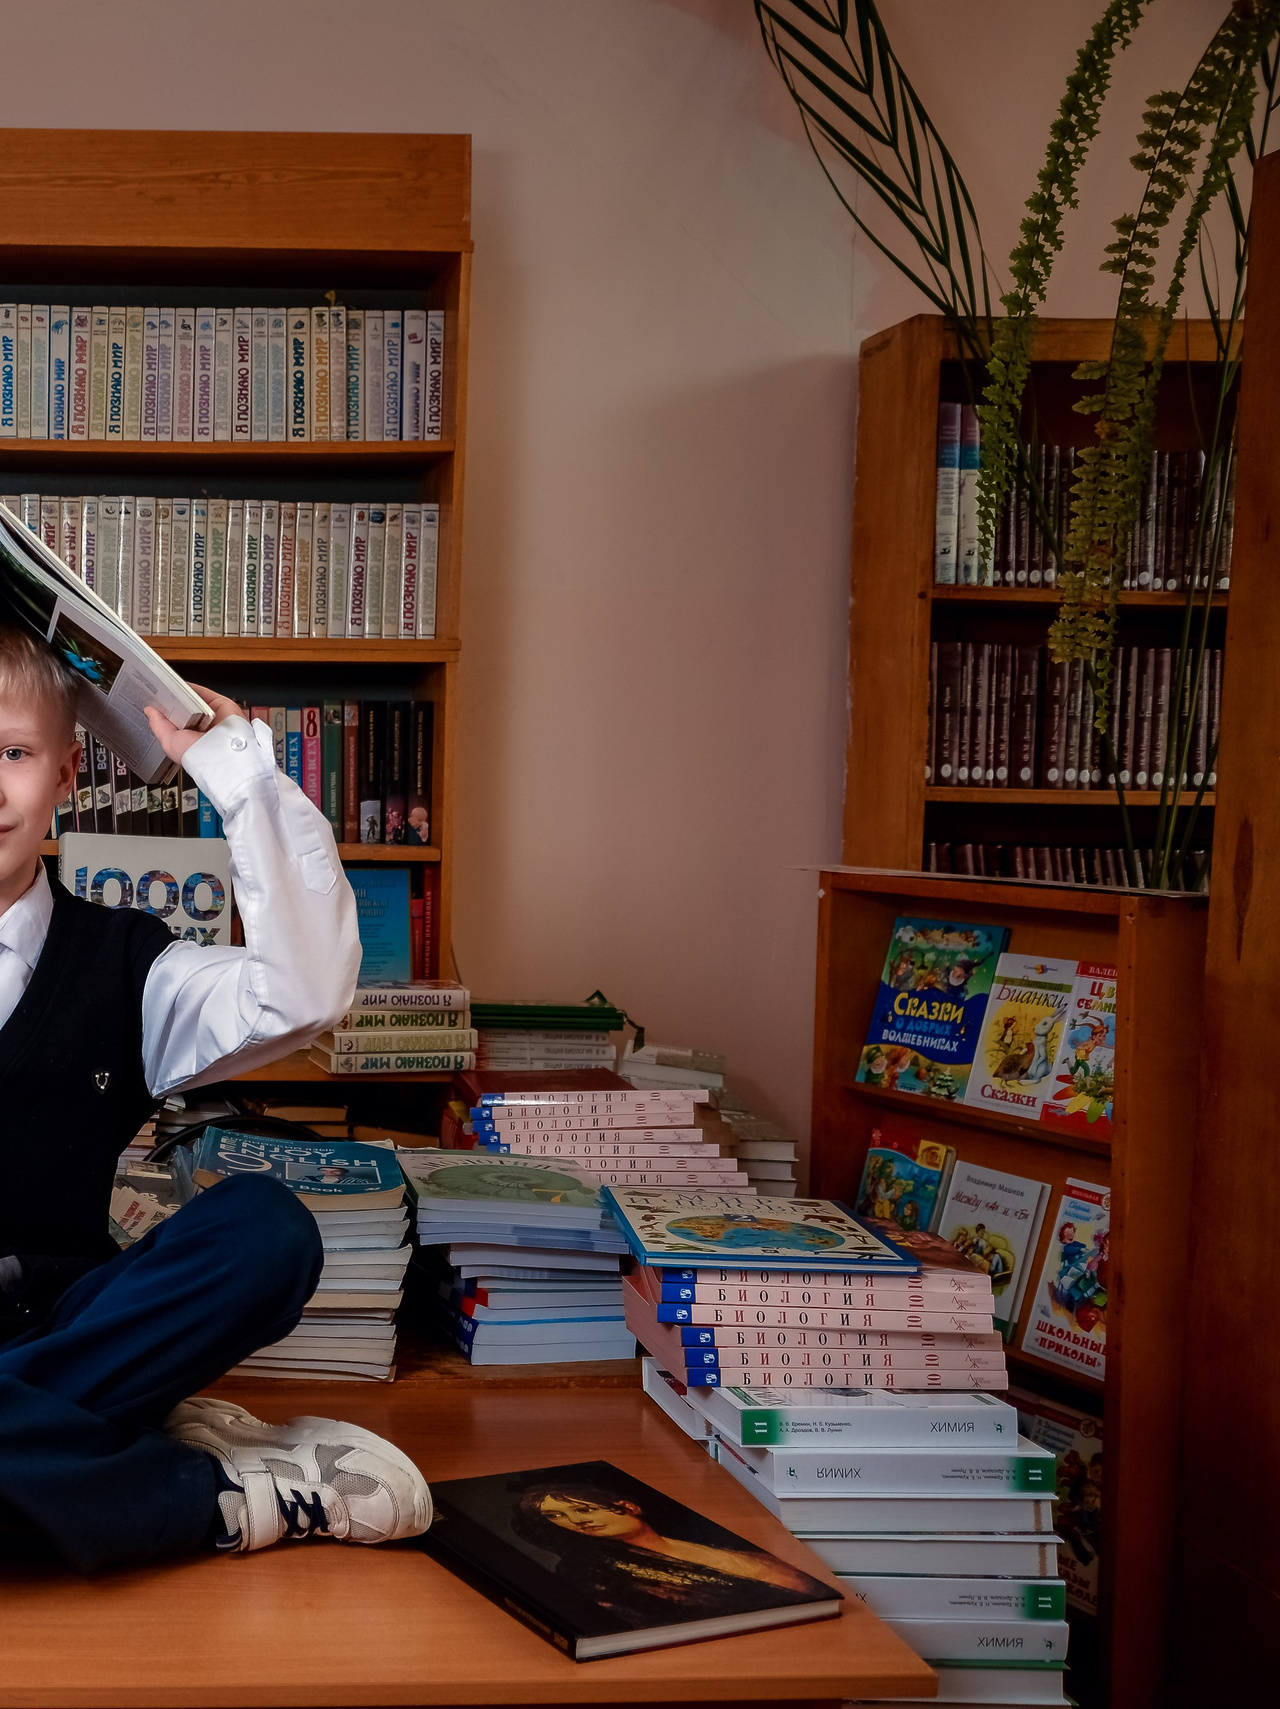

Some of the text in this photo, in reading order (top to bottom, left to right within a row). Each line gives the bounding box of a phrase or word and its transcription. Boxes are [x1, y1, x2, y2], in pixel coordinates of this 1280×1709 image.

[1, 335, 14, 427] Я ПОЗНАЮ МИР
[108, 342, 123, 434] Я ПОЗНАЮ МИР
[292, 337, 305, 438] Я ПОЗНАЮ МИР
[192, 532, 205, 623] Я ПОЗНАЮ МИР
[403, 532, 418, 631] Я ПОЗНАЮ МИР
[306, 709, 318, 738] 8
[289, 737, 299, 767] ВСЕХ
[307, 740, 318, 768] ВСЕХ
[74, 866, 226, 922] 1000
[362, 994, 452, 1007] Я ПОЗНАЮ МИР
[996, 978, 1068, 1009] Бианки
[355, 1012, 458, 1028] Я ПОЗНАЮ МИР
[906, 1019, 952, 1037] ДОБРЫХ
[881, 1029, 959, 1053] ВОЛШЕБНИКАХ
[981, 1083, 1038, 1108] Сказки
[507, 1102, 646, 1117] БИОЛОГИЯ 10
[510, 1116, 614, 1130] БИОЛОГИЯ
[515, 1132, 621, 1143] БИОЛОГИЯ
[526, 1144, 670, 1155] БИОЛОГИЯ 10
[585, 1158, 687, 1170] ЛОГИЯ 10
[966, 1174, 1025, 1198] Владимир Машков
[952, 1190, 982, 1213] Между
[719, 1269, 923, 1289] БИОЛОГИЯ 10
[717, 1289, 924, 1308] БИОЛОГИЯ 10
[714, 1309, 922, 1329] БИОЛОГИЯ 10
[736, 1332, 936, 1348] БИОЛОГИЯ 10
[740, 1352, 940, 1368] БИОЛОГИЯ 10
[743, 1372, 942, 1387] БИОЛОГИЯ 10
[753, 1421, 768, 1435] 11
[930, 1422, 975, 1433] ХИМИЯ
[816, 1468, 862, 1479] ХИМИЯ
[1028, 1469, 1042, 1481] 11
[1038, 1596, 1052, 1608] 11
[977, 1637, 1023, 1648] ХИМИЯ
